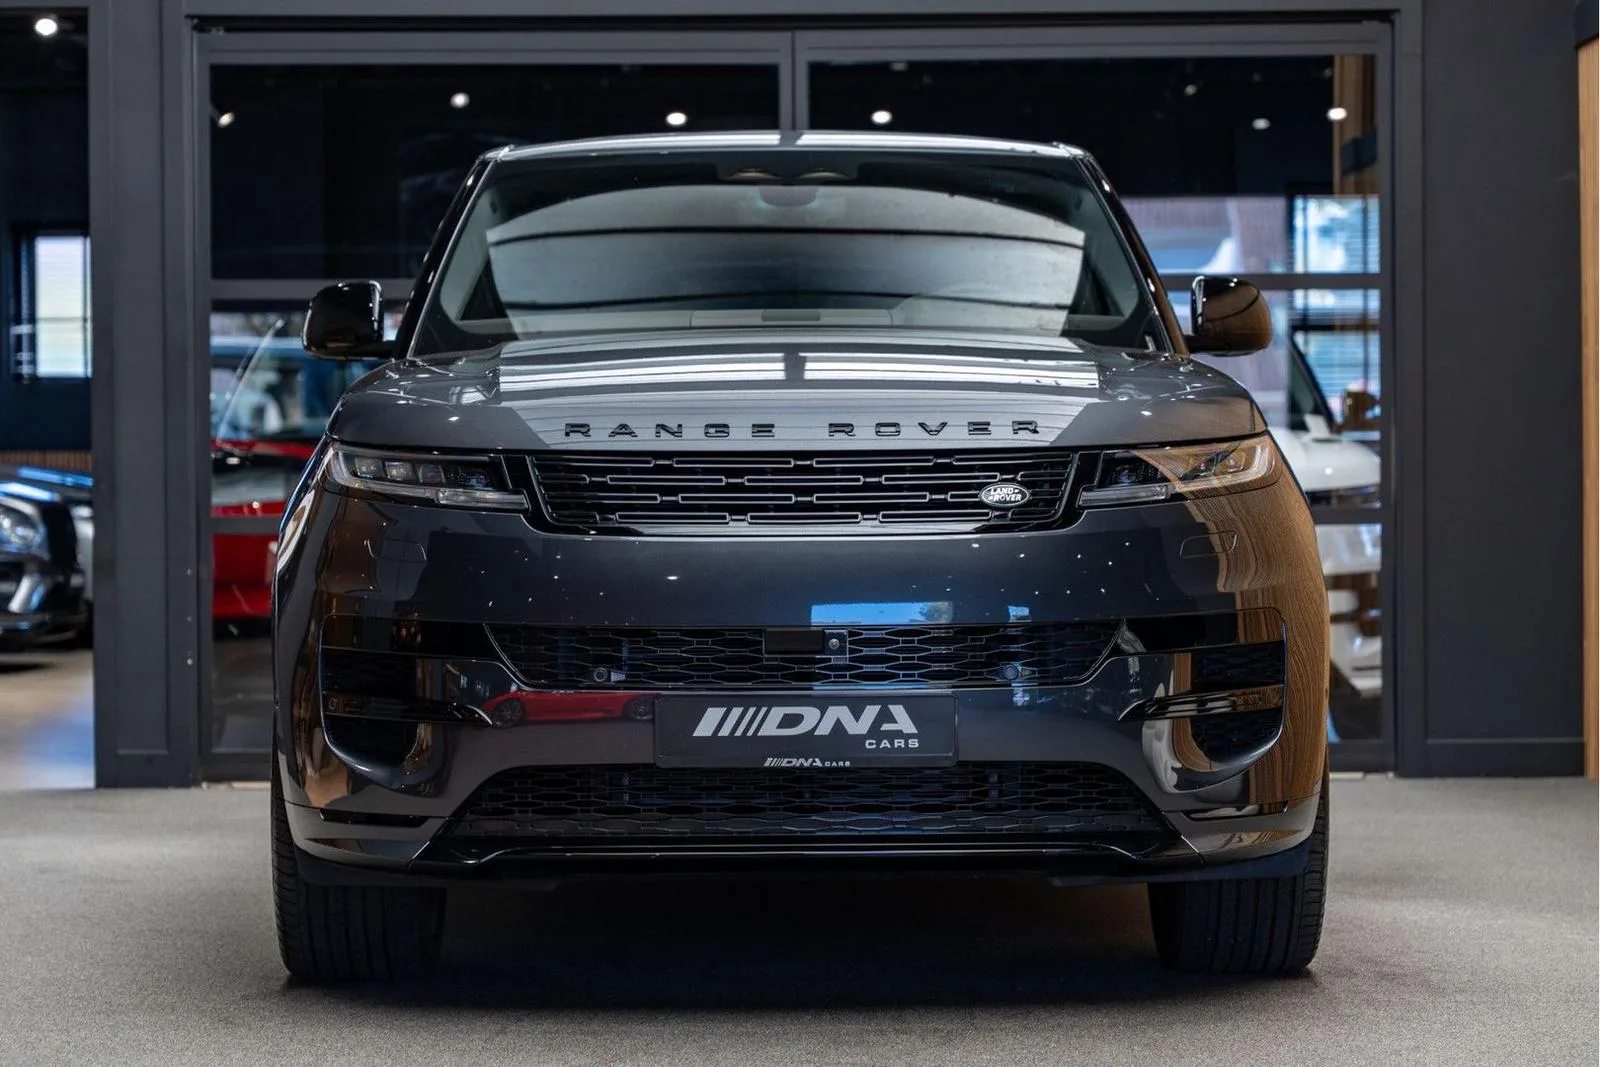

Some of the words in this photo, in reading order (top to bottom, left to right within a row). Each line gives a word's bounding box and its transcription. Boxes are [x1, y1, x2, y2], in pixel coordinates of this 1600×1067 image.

[564, 423, 776, 438] RANGE
[828, 420, 1040, 437] ROVER
[990, 487, 1014, 495] LAND
[993, 493, 1022, 502] ROVER
[757, 704, 918, 736] DNA
[865, 738, 920, 749] CARS
[781, 757, 823, 767] DNA
